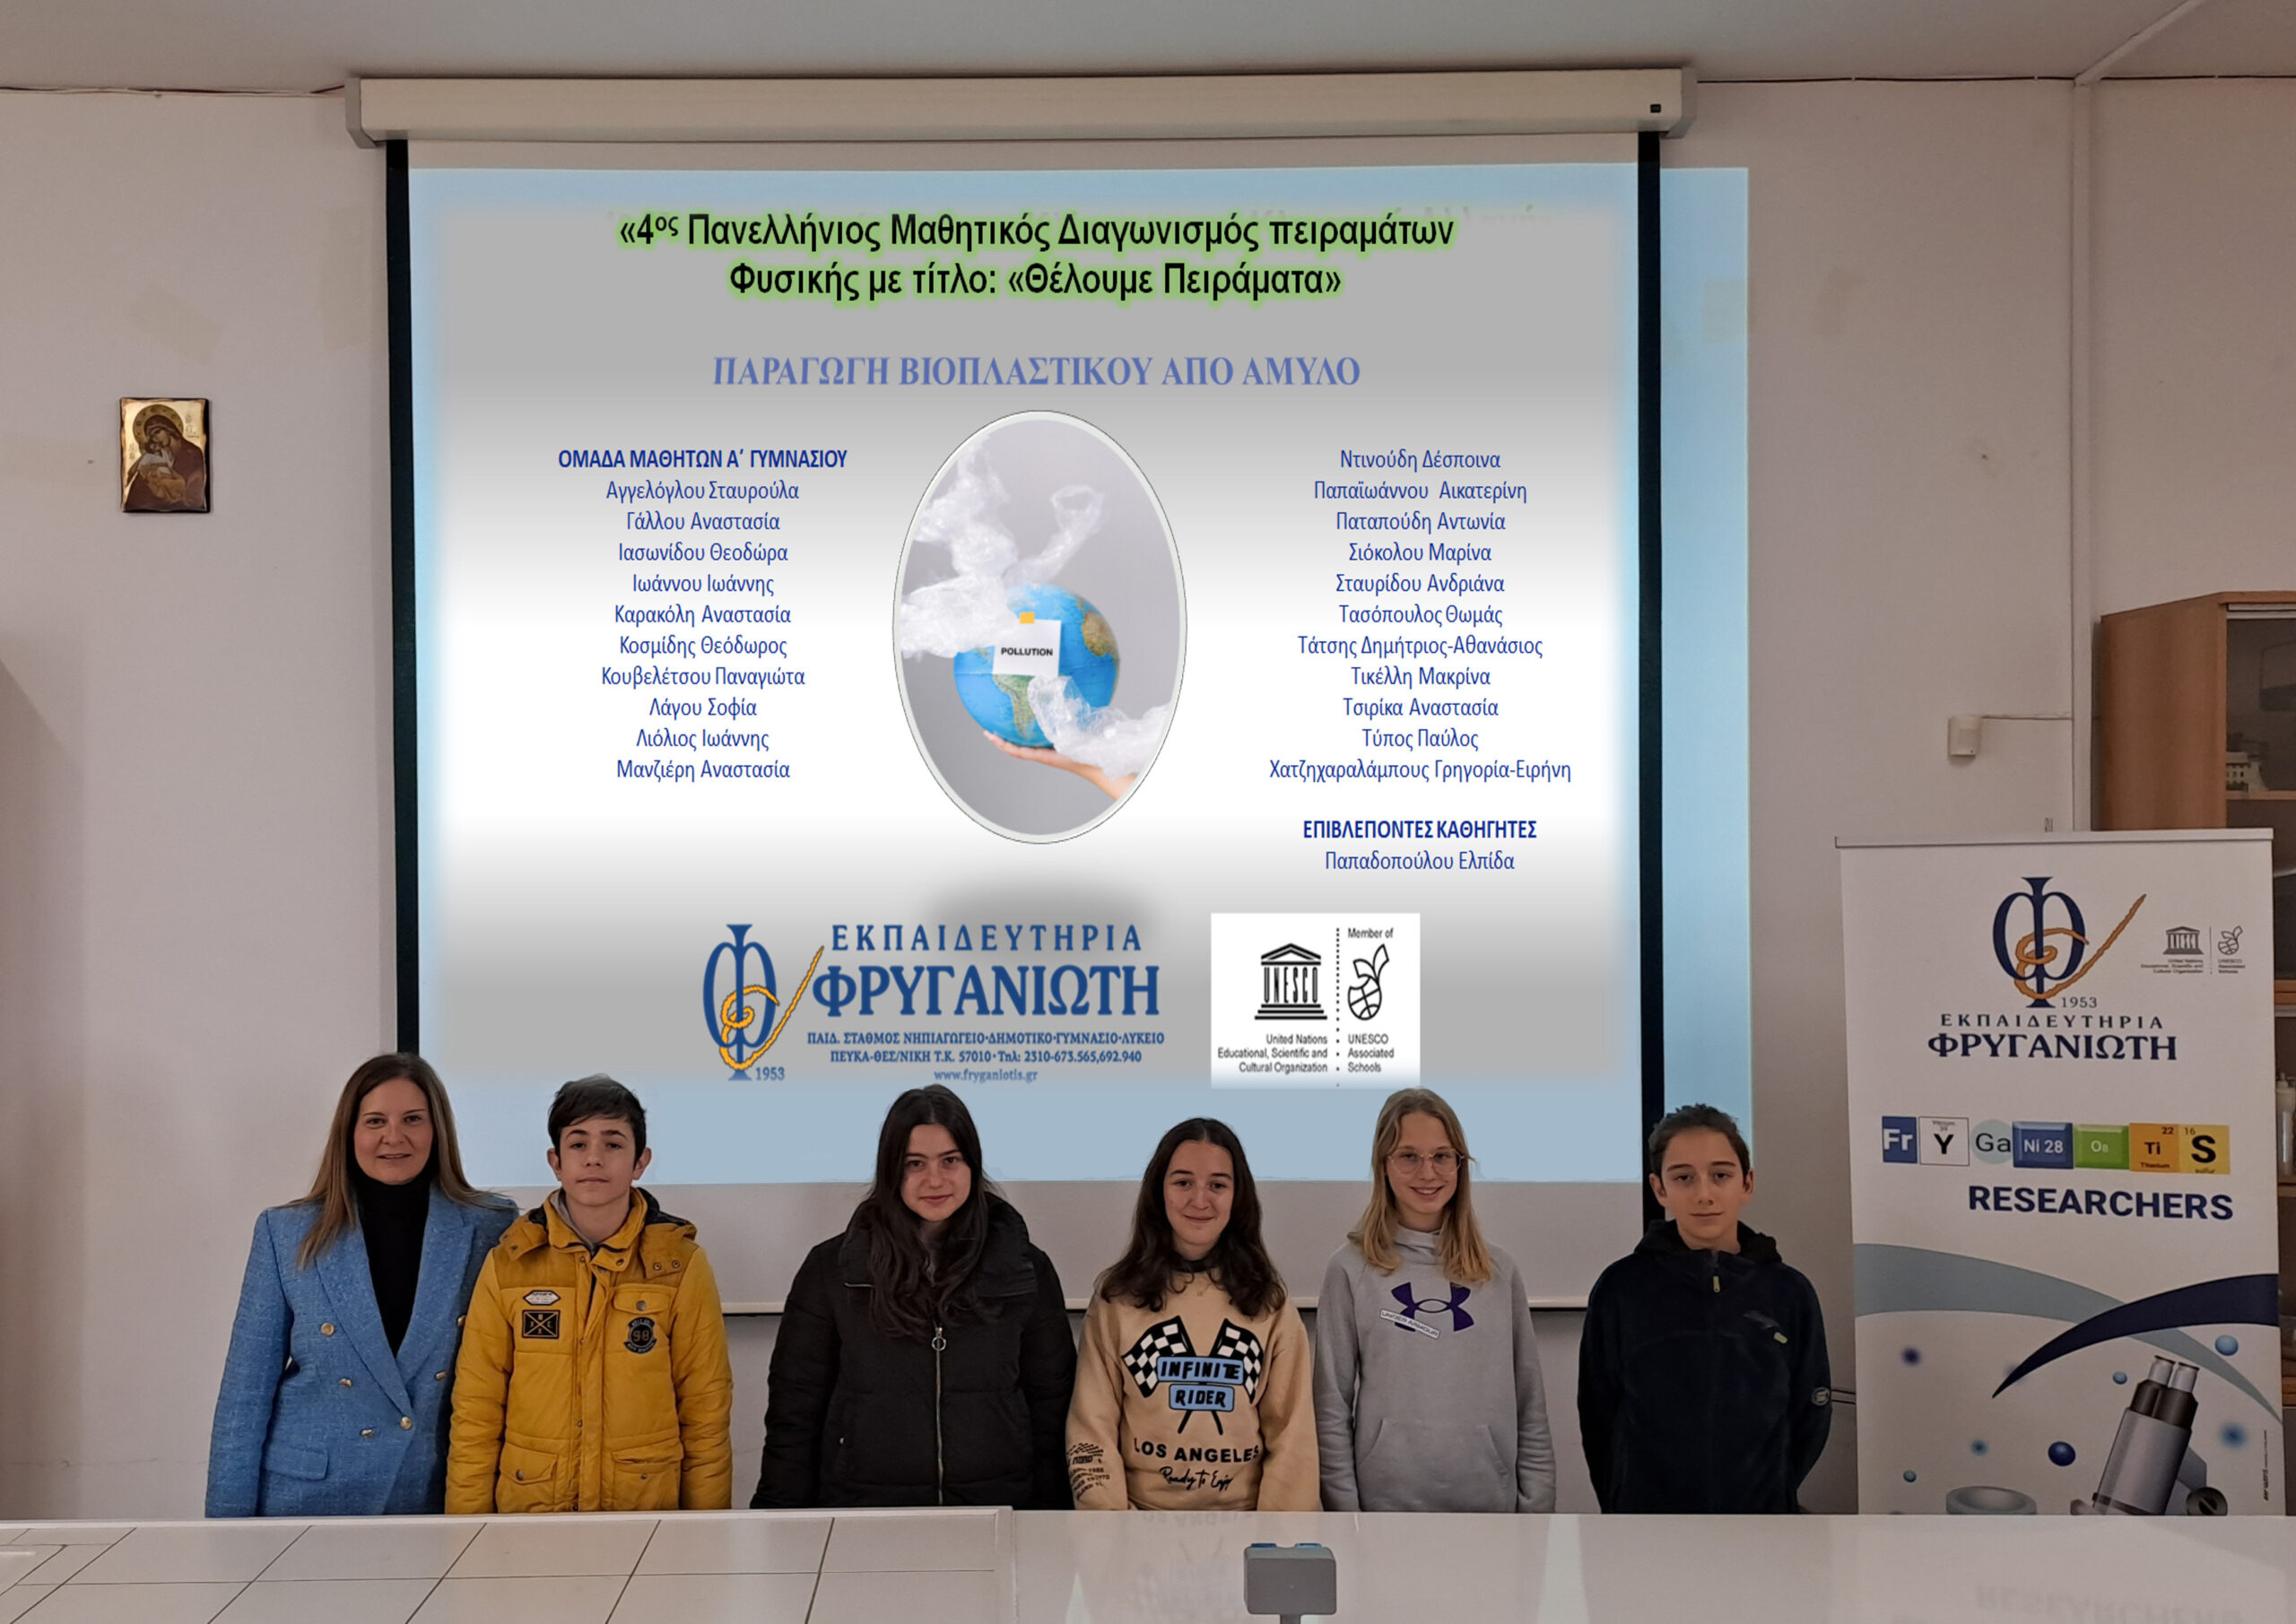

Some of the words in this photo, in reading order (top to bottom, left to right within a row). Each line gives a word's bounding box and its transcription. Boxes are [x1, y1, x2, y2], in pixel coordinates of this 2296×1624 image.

[689, 212, 881, 253] Πανελλήνιος
[891, 212, 1051, 253] Μαθητικός
[1057, 212, 1259, 253] Διαγωνισμός
[1268, 212, 1454, 253] πειραμάτων
[730, 261, 860, 302] Φυσικής
[869, 270, 902, 302] με
[912, 261, 996, 294] τίτλο:
[1008, 261, 1153, 302] «Θέλουμε
[1164, 261, 1342, 302] Πειράματα»
[714, 357, 889, 386] ΠΑΡΑΓΩΓΗ
[900, 357, 1153, 386] ΒΙΟΠΛΑΣΤΙΚΟΥ
[1161, 357, 1234, 386] ΑΠΟ
[1241, 357, 1361, 386] ΑΜΥΛΟ
[558, 449, 626, 468] ΟΜΑΔΑ
[630, 449, 723, 468] ΜΑΘΗΤΩΝ
[750, 449, 848, 468] ΓΥΜΝΑΣΙΟΥ
[1340, 447, 1418, 473] Ντινούδη
[1422, 449, 1501, 468] Δέσποινα
[605, 479, 705, 504] Αγγελόγλου
[709, 479, 800, 504] Σταυρούλα
[1314, 480, 1429, 499] Παπαϊωάννου
[1439, 480, 1527, 504] Αικατερίνη
[627, 509, 685, 530] Γάλλου
[690, 511, 781, 530] Αναστασία
[1336, 510, 1432, 535] Παταπούδη
[1437, 511, 1507, 530] Αντωνία
[619, 541, 705, 561] Ιασωνίδου
[709, 541, 789, 566] Θεοδώρα
[1349, 541, 1424, 561] Σιόκολου
[1429, 543, 1492, 566] Μαρίνα
[633, 573, 702, 593] Ιωάννου
[707, 573, 775, 597] Ιωάννης
[1335, 572, 1422, 597] Σταυρίδου
[1426, 572, 1506, 597] Ανδριάνα
[614, 603, 695, 629] Καρακόλη
[701, 604, 792, 623] Αναστασία
[1338, 603, 1443, 629] Τασόπουλος
[1445, 604, 1503, 629] Θωμάς
[620, 634, 697, 659] Κοσμίδης
[700, 634, 787, 659] Θεόδωρος
[1000, 647, 1054, 656] POLLUTION
[1297, 635, 1358, 659] Τάτσης
[1361, 634, 1544, 659] Δημήτριος-Αθανάσιος
[602, 664, 711, 690] Κουβελέτσου
[715, 666, 805, 690] Παναγιώτα
[1350, 664, 1413, 690] Τικέλλη
[1419, 666, 1492, 690] Μακρίνα
[648, 697, 702, 721] Λάγου
[708, 696, 758, 721] Σοφία
[1342, 697, 1405, 721] Τσιρίκα
[1408, 697, 1500, 716] Αναστασία
[636, 726, 697, 752] Λιόλιος
[702, 728, 770, 752] Ιωάννης
[1361, 728, 1413, 752] Τύπος
[1418, 727, 1479, 752] Παύλος
[617, 759, 695, 783] Μανζιέρη
[700, 759, 791, 778] Αναστασία
[1269, 758, 1430, 784] Χατζηχαραλάμπους
[1435, 759, 1571, 783] Γρηγορία-Ειρήνη
[1303, 820, 1434, 838] ΕΠΙΒΛΕΠΟΝΤΕΣ
[1437, 820, 1537, 838] ΚΑΘΗΓΗΤΕΣ
[1326, 849, 1454, 870] Παπαδοπούλου
[1458, 849, 1515, 870] Ελπίδα
[831, 923, 1142, 951] ΕΚΠΑΙΔΕΥΤΗΡΙΑ
[1347, 927, 1383, 939] Member
[1384, 926, 1395, 939] of
[813, 965, 1160, 1017] ΦΡΥΓΑΝΙΩΤΗ
[1264, 967, 1318, 1003] UNESCO
[2061, 996, 2098, 1009] 1953
[1941, 1013, 2163, 1029] ΕΚΠΑΙΔΕΥΤΗΡΙΑ
[807, 1031, 840, 1045] ΠΑΙΔ.
[843, 1031, 900, 1045] ΣΤΑΘΜΟΣ
[1265, 1033, 1294, 1046] United
[1295, 1033, 1328, 1046] Nations
[1347, 1032, 1389, 1046] UNESCO
[1927, 1032, 2177, 1061] ΦΡΥΓΑΝΙΩΤΗ
[830, 1050, 931, 1063] ΠΕΥΚΑ-ΘΕΣ/ΝΙΚΗ
[933, 1050, 955, 1063] Τ.Κ.
[1023, 1049, 1143, 1064] 2310-673.565,692.940
[1217, 1046, 1270, 1060] Educational,
[1271, 1046, 1309, 1059] Scientific
[1311, 1047, 1328, 1059] and
[1347, 1046, 1395, 1059] Associated
[755, 1065, 786, 1081] 1953
[933, 1068, 1039, 1083] www.fryganiotis.gr
[1238, 1061, 1273, 1073] Cultural
[1274, 1061, 1328, 1076] Organization
[1347, 1061, 1382, 1073] Schools
[2185, 1127, 2196, 1135] 16
[1883, 1129, 1913, 1151] Fr
[1934, 1133, 1953, 1154] Y
[1976, 1133, 2011, 1152] Ga
[2024, 1140, 2039, 1152] Ni
[2044, 1140, 2063, 1153] 28
[2144, 1142, 2161, 1154] Ti
[2191, 1135, 2216, 1163] S
[1969, 1185, 2233, 1220] RESEARCHERS
[633, 1330, 649, 1342] 98
[1161, 1361, 1239, 1380] INFINITE
[1175, 1390, 1226, 1408] RIDER
[1134, 1437, 1166, 1458] LOS
